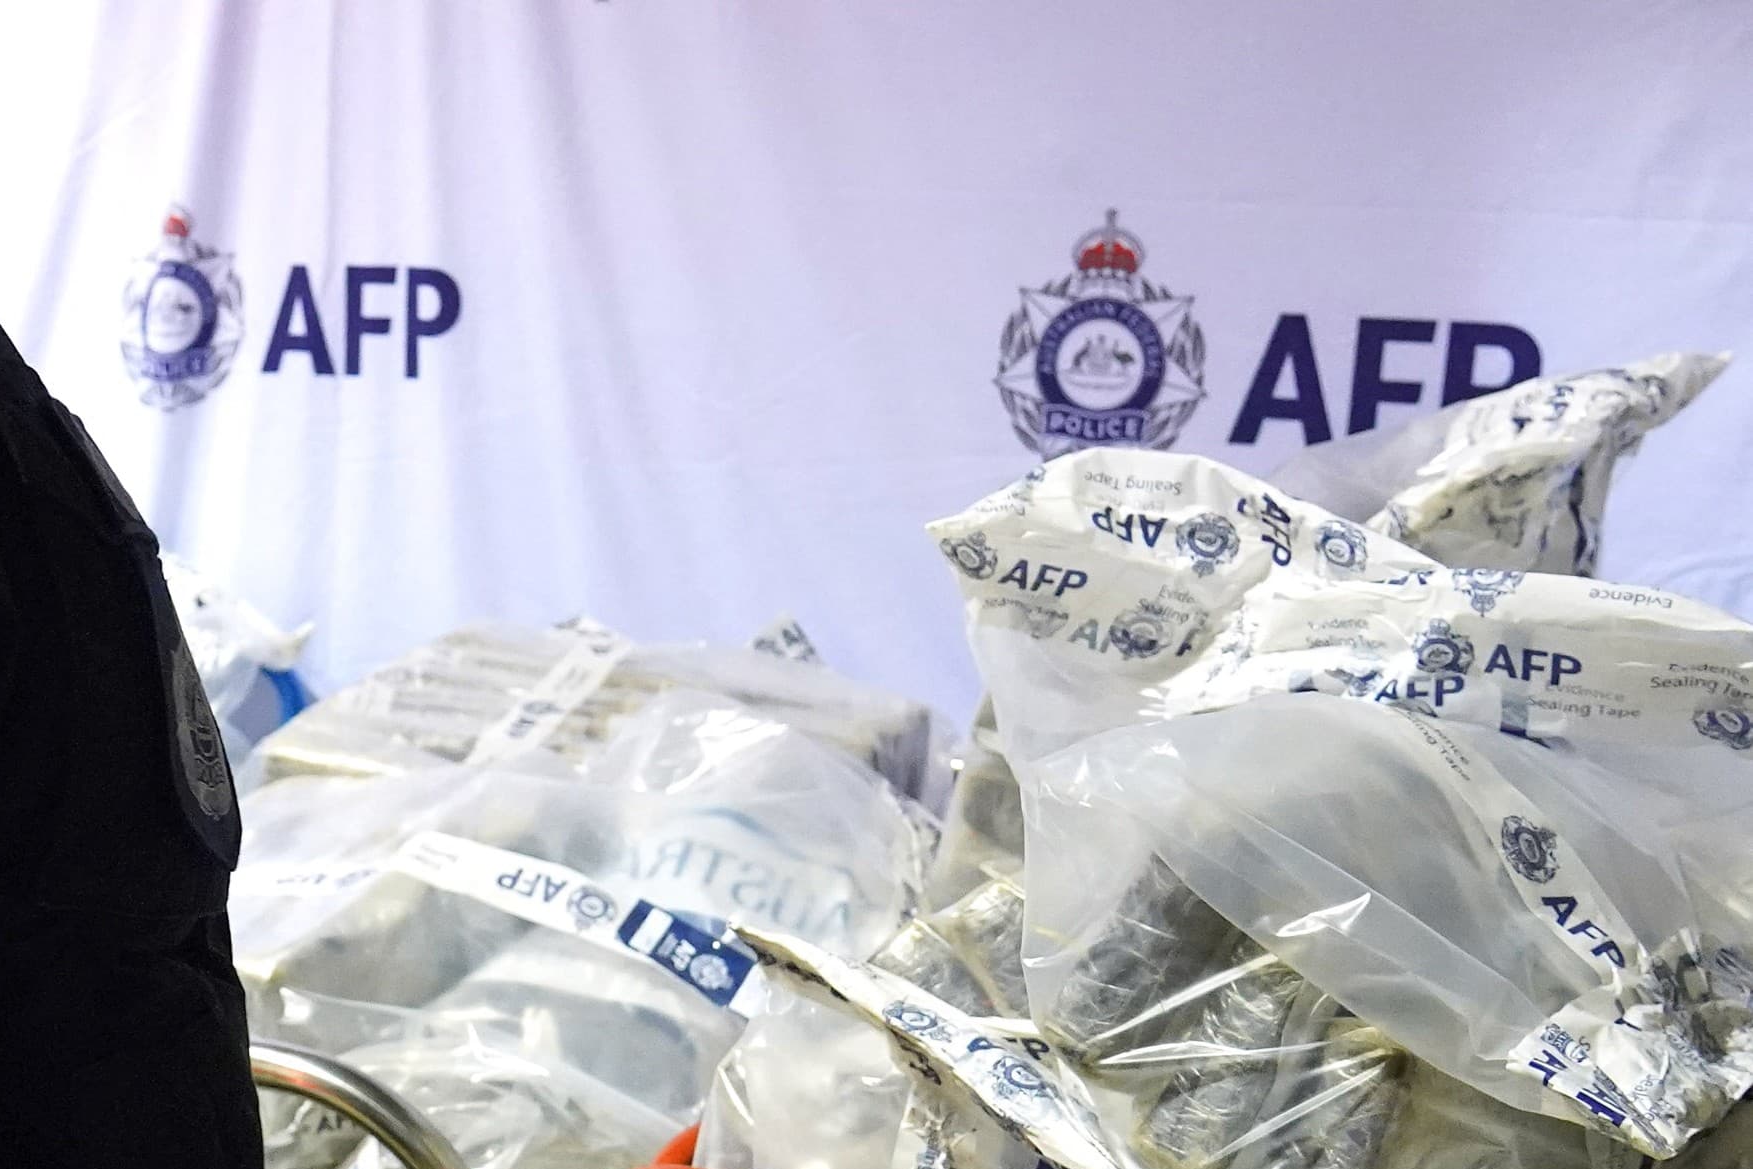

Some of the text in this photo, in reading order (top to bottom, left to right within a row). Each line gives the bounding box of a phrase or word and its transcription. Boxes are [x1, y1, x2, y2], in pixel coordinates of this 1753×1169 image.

[261, 264, 462, 379] AFP
[1227, 312, 1542, 446] AFP
[1048, 410, 1143, 438] POLICE
[1084, 470, 1183, 496] Sealing Tape
[1092, 506, 1168, 548] AFP
[1261, 493, 1292, 567] AFP
[997, 559, 1089, 598] AFP
[1589, 587, 1674, 609] Evidence
[1484, 643, 1582, 687] AFP
[1649, 674, 1719, 699] Sealing
[1527, 696, 1642, 721] Sealing Tape
[496, 867, 568, 903] AFP
[1541, 895, 1626, 969] AFP
